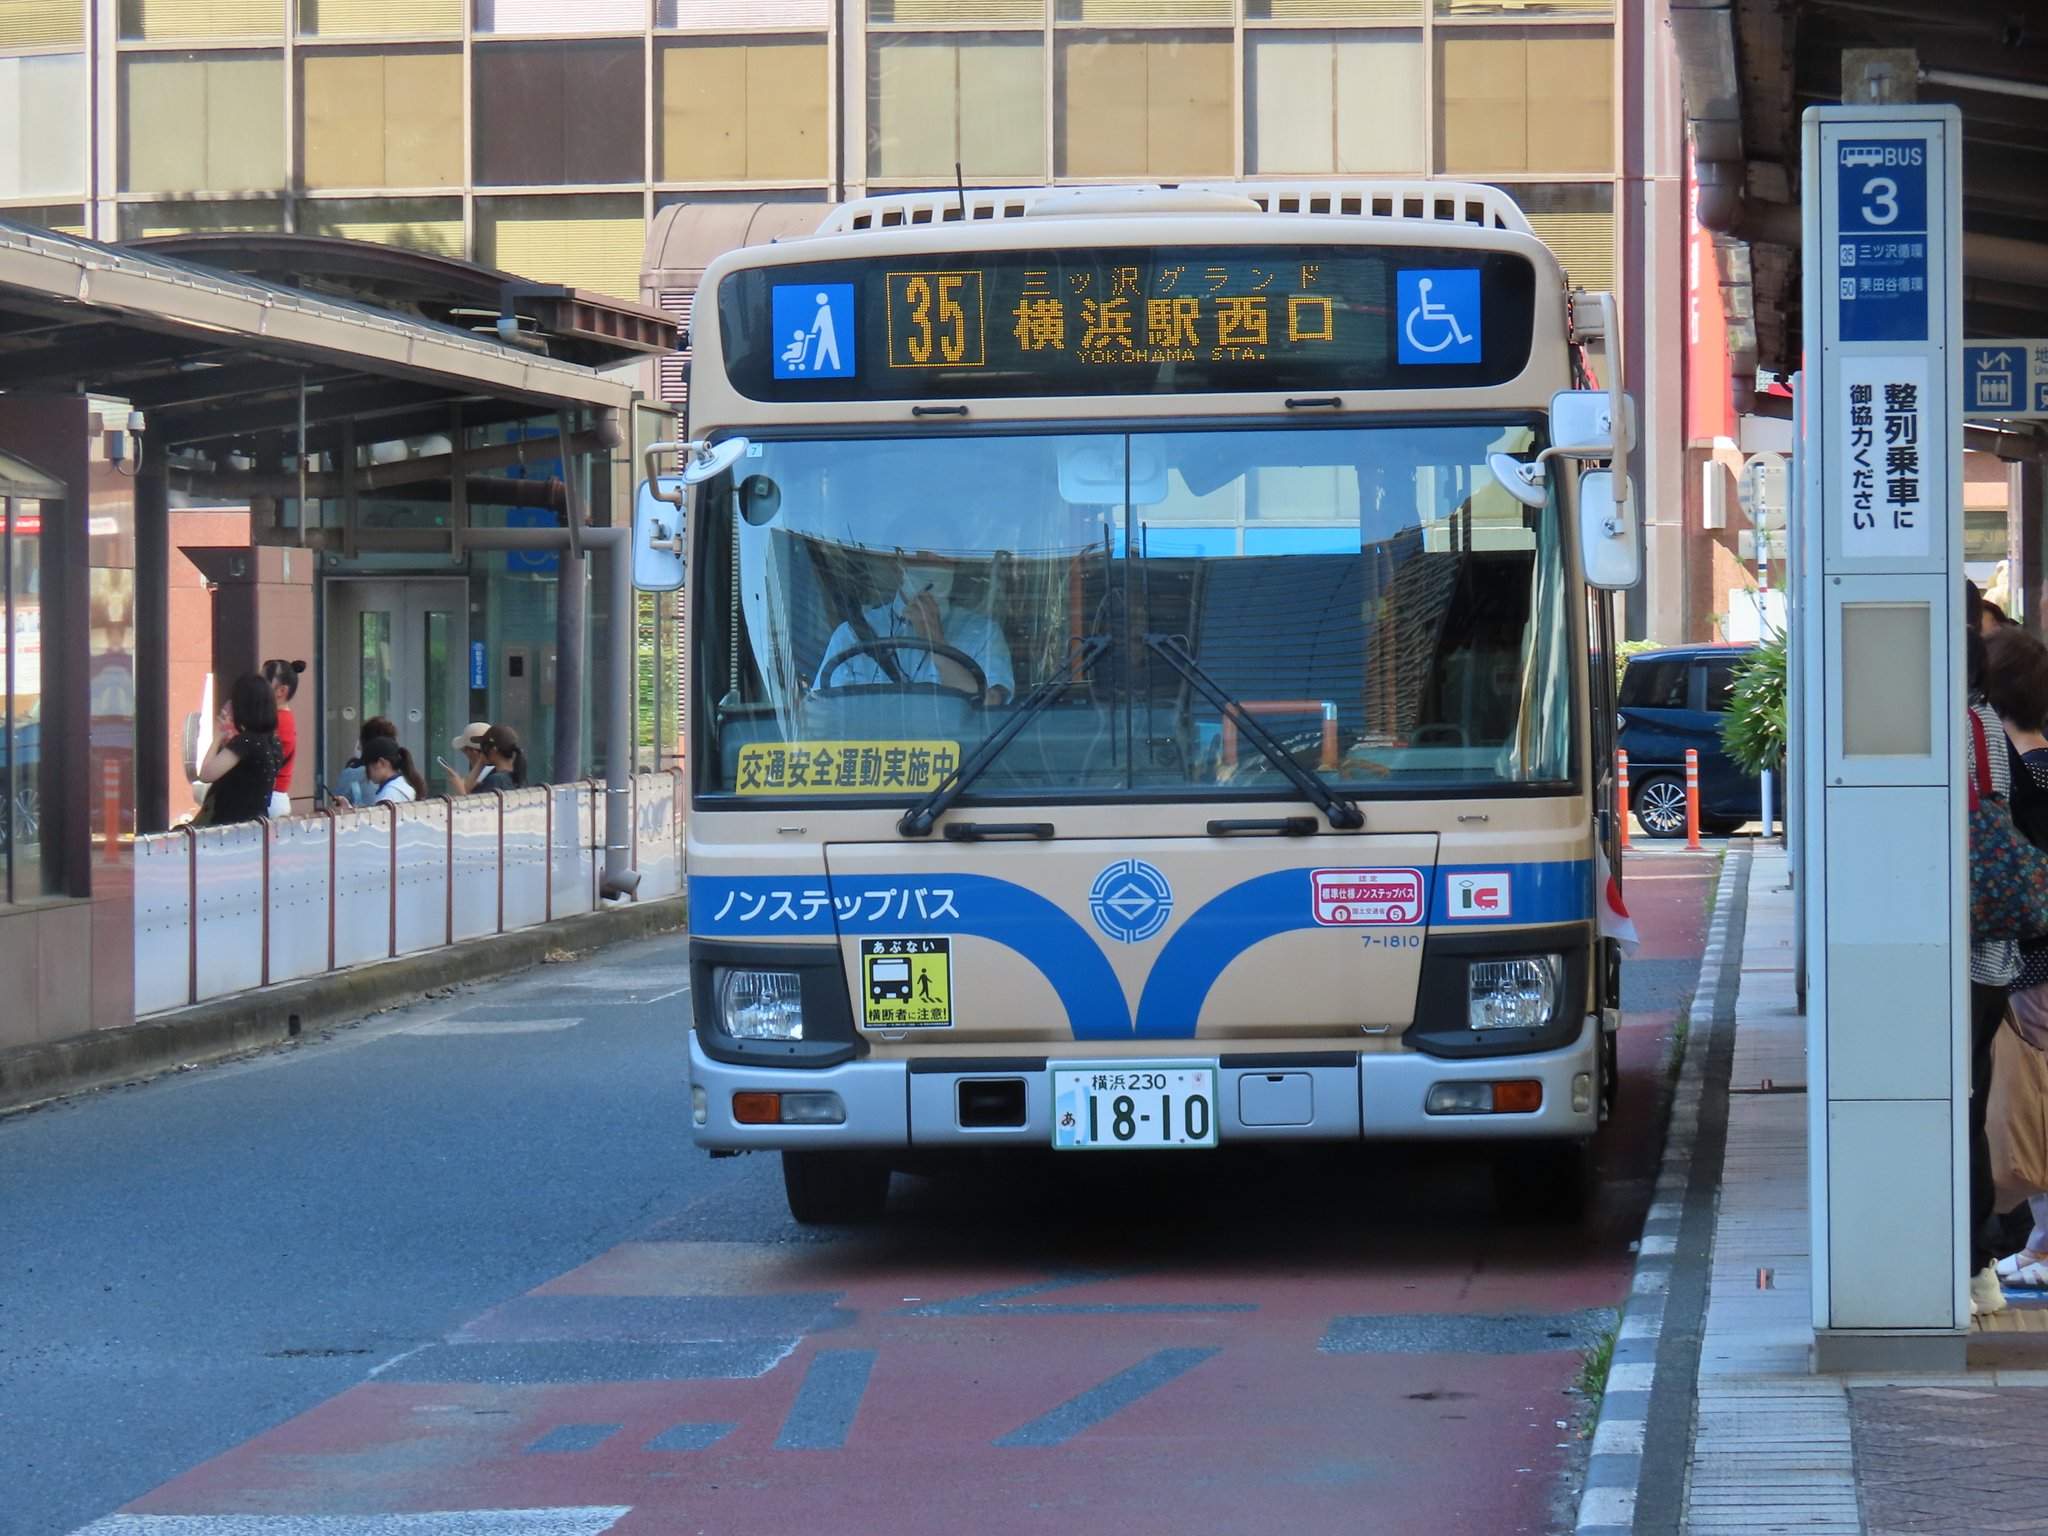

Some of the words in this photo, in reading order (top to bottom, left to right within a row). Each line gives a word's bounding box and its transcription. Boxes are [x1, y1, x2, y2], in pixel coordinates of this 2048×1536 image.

[1885, 147, 1922, 166] BUS
[1861, 177, 1898, 225] 3
[1841, 247, 1854, 263] 35
[1859, 244, 1923, 258] 三ツ沢循環
[1022, 265, 1319, 296] 三ツ沢グランド
[1841, 280, 1854, 297] 50
[906, 277, 964, 362] 35
[1012, 296, 1334, 350] 横浜駅西口
[1076, 348, 1196, 364] YOKOHAMA
[1211, 347, 1265, 361] STA.
[1850, 384, 1875, 530] 御協力ください
[1884, 383, 1919, 529] 整列乗車に
[740, 747, 955, 790] 交通安全運動実施中
[714, 887, 960, 921] ノンステップバス
[1322, 887, 1414, 900] 標準仕様ノンステップバス
[873, 941, 935, 953] あぶない
[1361, 935, 1420, 948] 7-1810
[868, 1008, 947, 1021] 横断者に注意!
[1061, 1111, 1076, 1127] あ
[1089, 1094, 1209, 1141] 18-10
